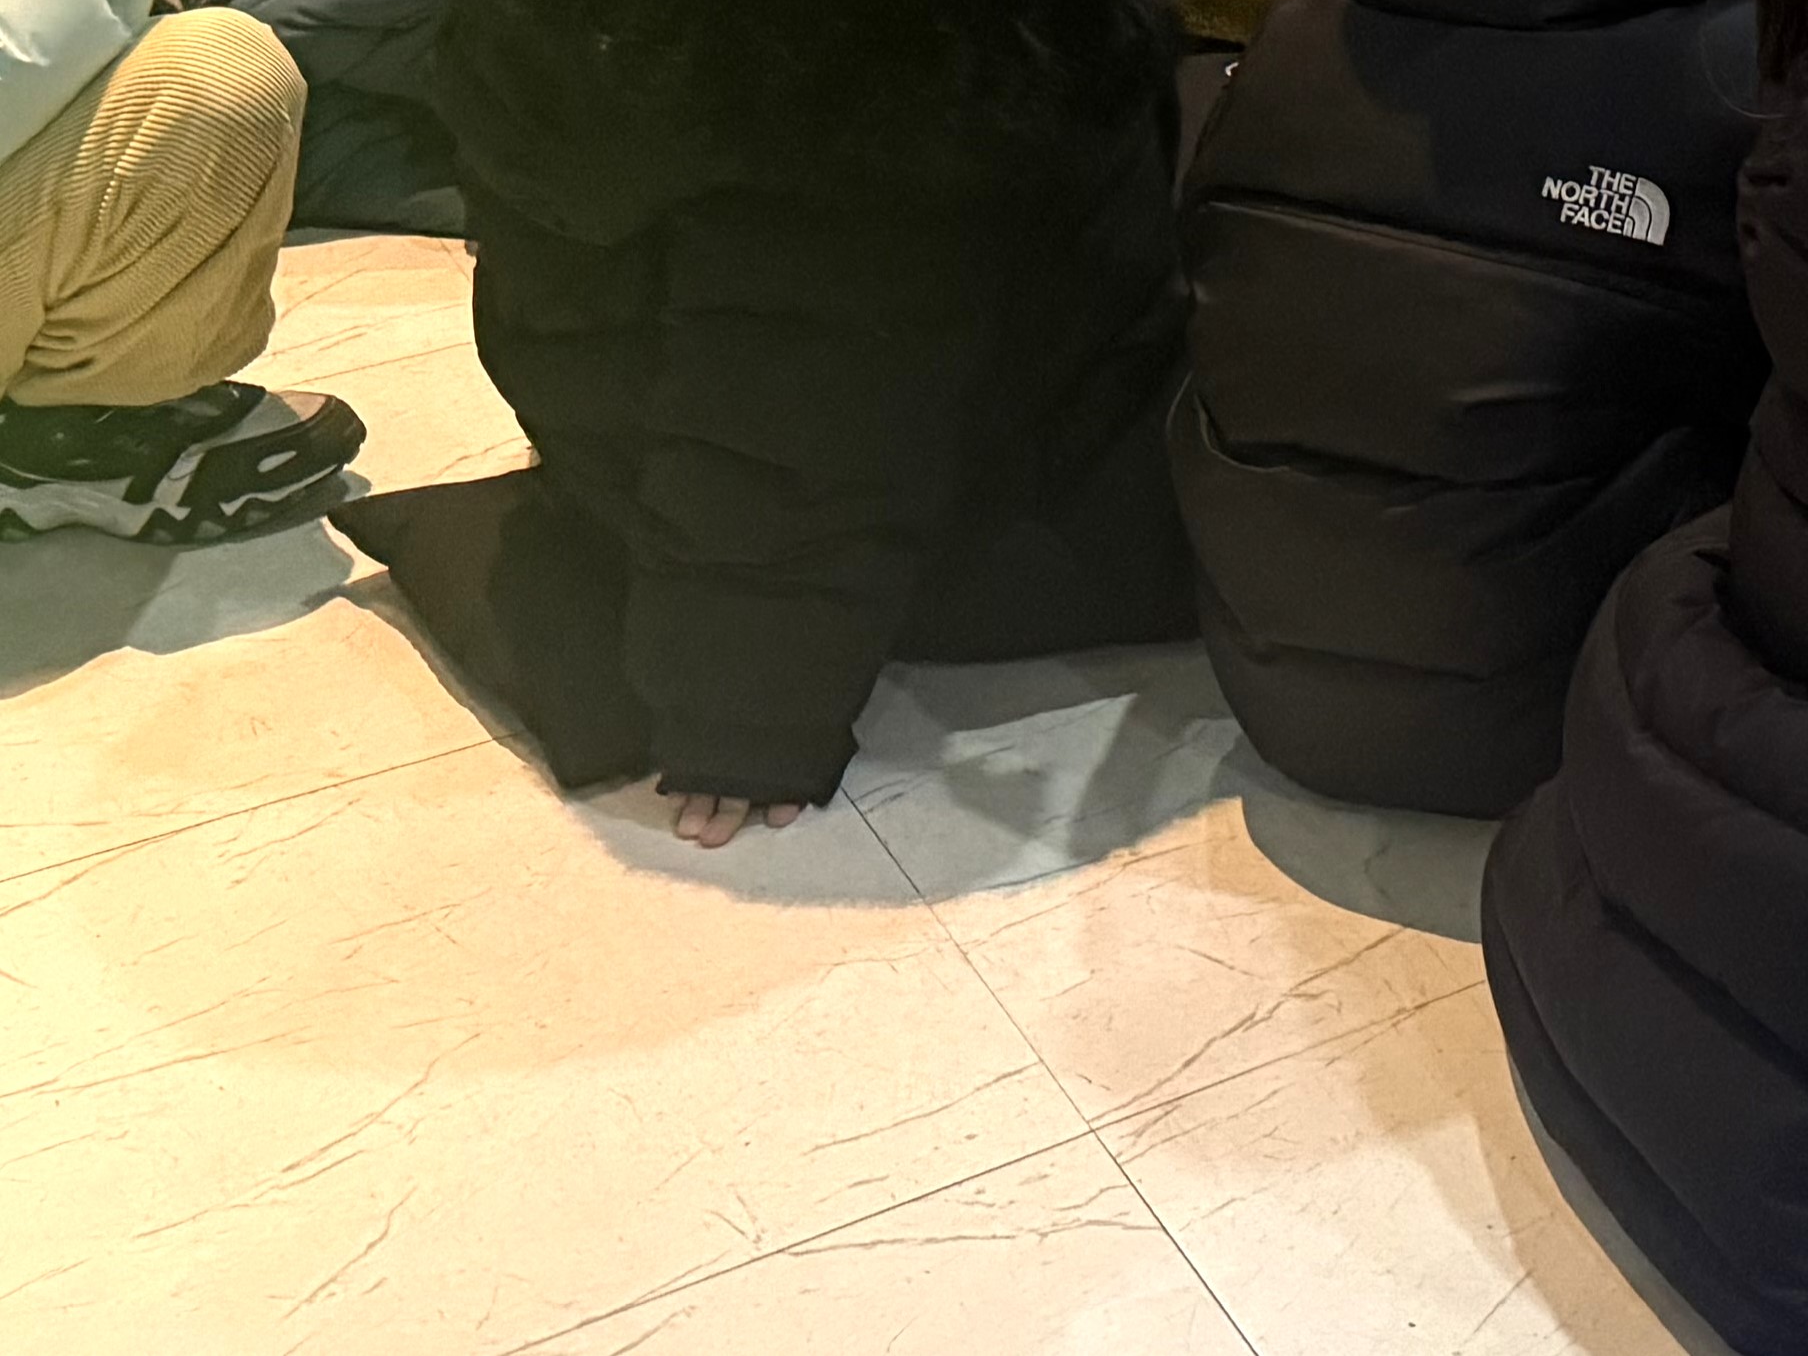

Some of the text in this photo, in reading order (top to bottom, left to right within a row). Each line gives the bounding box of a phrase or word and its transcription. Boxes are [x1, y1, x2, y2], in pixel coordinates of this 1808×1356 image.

[1541, 176, 1630, 215] NORTH
[1588, 165, 1637, 195] THE
[1560, 203, 1625, 235] FACE
